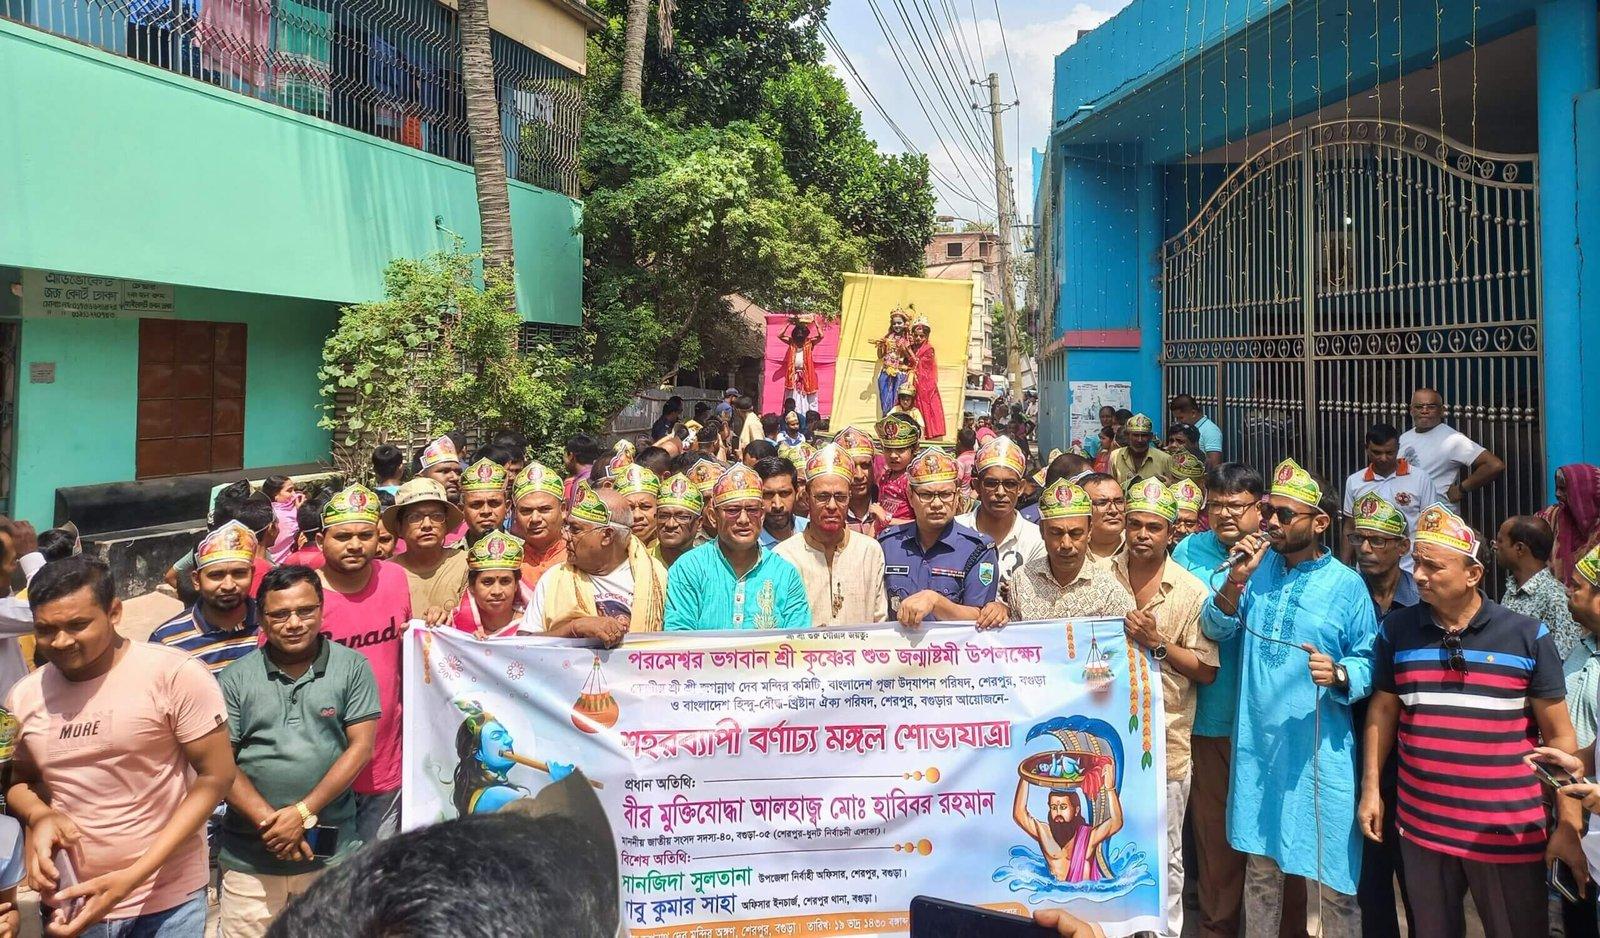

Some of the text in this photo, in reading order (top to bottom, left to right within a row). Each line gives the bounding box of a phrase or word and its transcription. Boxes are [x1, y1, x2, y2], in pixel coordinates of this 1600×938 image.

[628, 650, 705, 671] পরমেশ্বর
[710, 650, 770, 670] ভগবান
[775, 643, 796, 670] শ্রী
[801, 649, 856, 675] কৃষ্ণের
[861, 649, 891, 665] শুভ
[895, 642, 960, 668] জন্মাষ্টমী
[739, 681, 758, 693] দেব
[761, 678, 789, 692] মন্দির
[828, 679, 873, 691] বাংলাদেশ
[876, 678, 895, 692] পূজা
[939, 675, 975, 690] পরিষদ,
[978, 676, 1016, 689] শেরপুর,
[671, 701, 680, 711] ও
[683, 700, 730, 712] বাংলাদেশ
[818, 694, 840, 709] ঐক্য
[844, 694, 877, 709] পরিষদ,
[881, 695, 917, 709] শেরপুর,
[920, 694, 953, 708] বগুড়ার
[59, 720, 101, 739] MORE
[620, 717, 1012, 760] শহরব্যাপী বর্ণাঢ্য মঙ্গল শোভাযাত্রা
[624, 778, 653, 793] প্রধান
[623, 788, 996, 834] বীর মুক্তিযোদ্ধা আলহাজ্ব মোঃ হাবিবর রহমান
[647, 834, 671, 847] জাতীয়
[674, 836, 695, 845] সংসদ
[824, 826, 851, 838] নির্বাচনী
[621, 850, 650, 867] বিশেষ
[690, 866, 753, 894] সুলতানা
[758, 872, 789, 884] উপজেলা
[791, 869, 814, 882] নির্বাহী
[851, 869, 880, 881] শেরপুর,
[651, 896, 696, 924] কুমার
[700, 893, 738, 915] সাহা
[741, 898, 771, 910] অফিসার
[803, 895, 829, 907] শেরপুর
